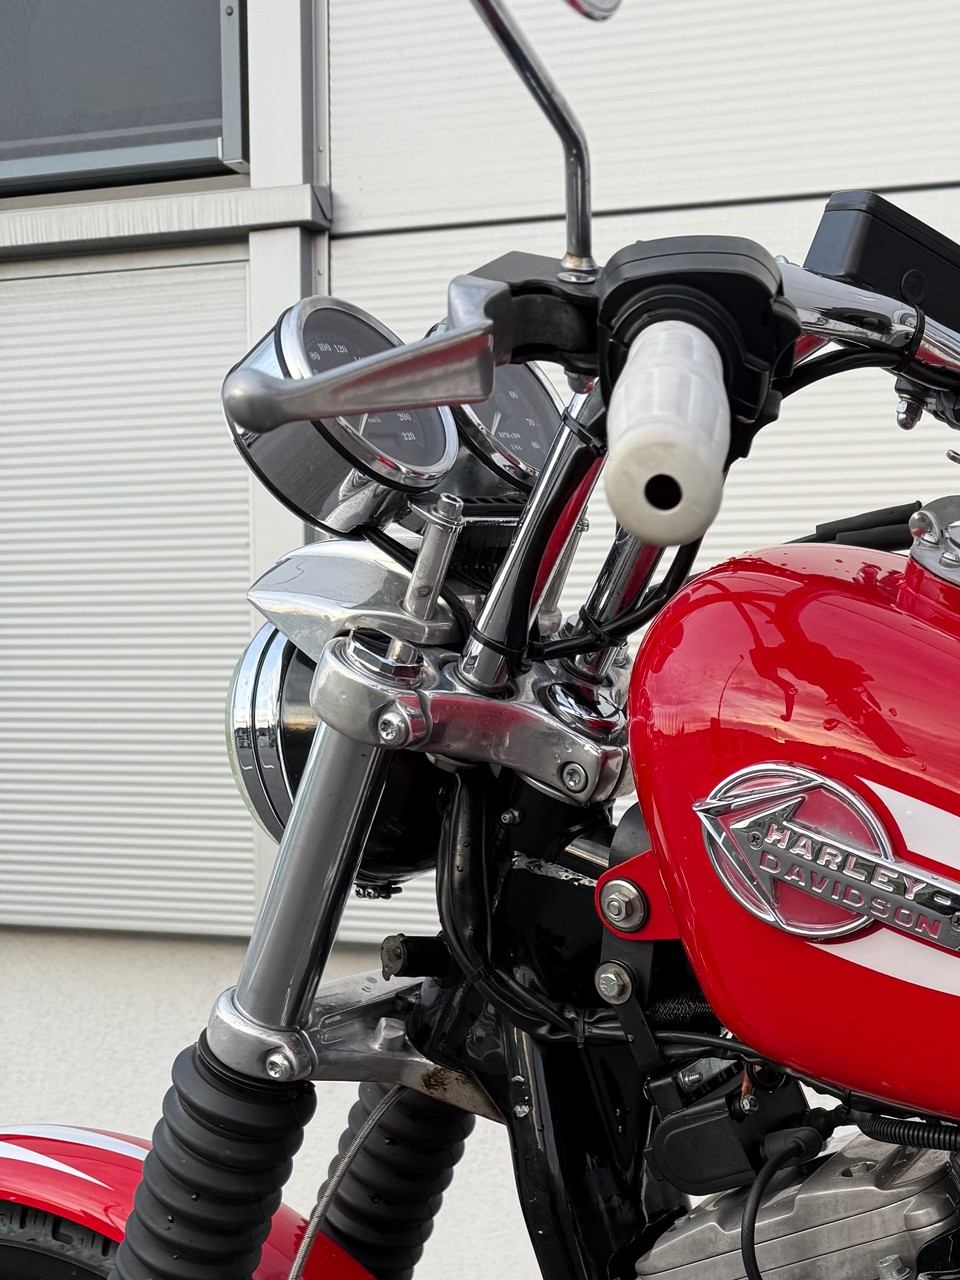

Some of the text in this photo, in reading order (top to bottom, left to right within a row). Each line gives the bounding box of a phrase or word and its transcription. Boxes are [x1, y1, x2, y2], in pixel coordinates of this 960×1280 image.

[316, 342, 349, 354] 100 120
[308, 351, 321, 361] 80
[400, 431, 416, 441] 220
[759, 849, 942, 940] DAVIDSON
